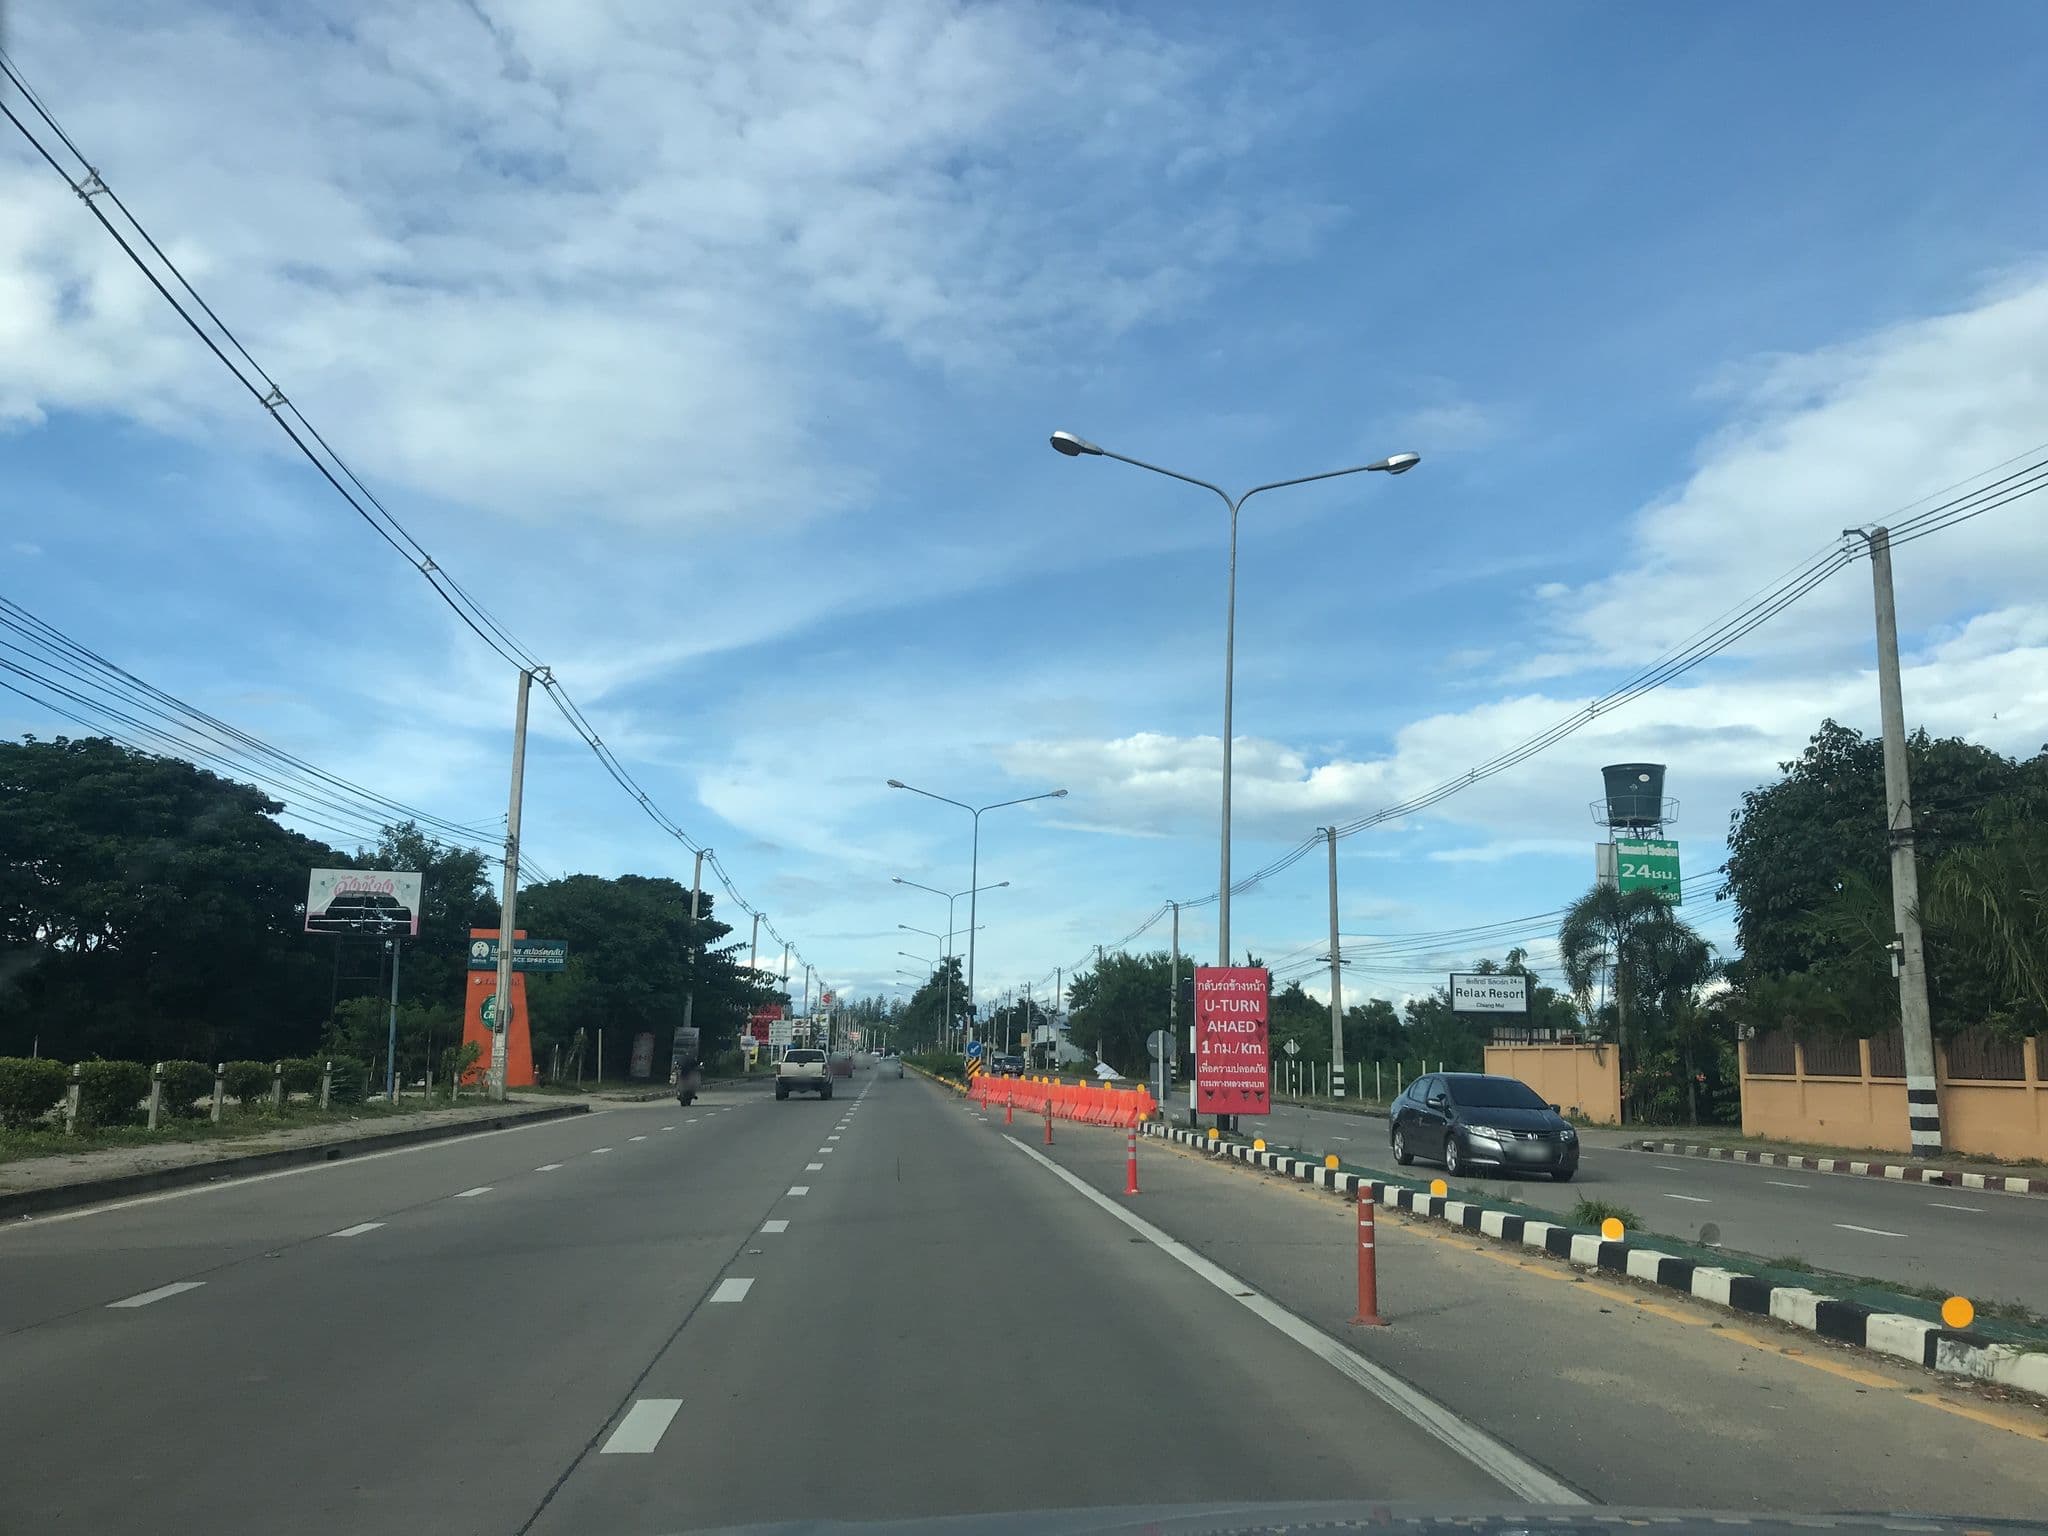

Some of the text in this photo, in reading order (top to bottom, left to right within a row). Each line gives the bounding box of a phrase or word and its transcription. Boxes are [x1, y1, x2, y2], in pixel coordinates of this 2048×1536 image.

[1198, 979, 1266, 992] กลับรถข้างหน้า
[1456, 988, 1524, 998] Relax Resort
[1204, 999, 1260, 1012] U-TURN
[1207, 1020, 1256, 1033] AHAED
[1201, 1040, 1210, 1054] 1
[1199, 1060, 1267, 1073] เพื่อความปลอดภัย
